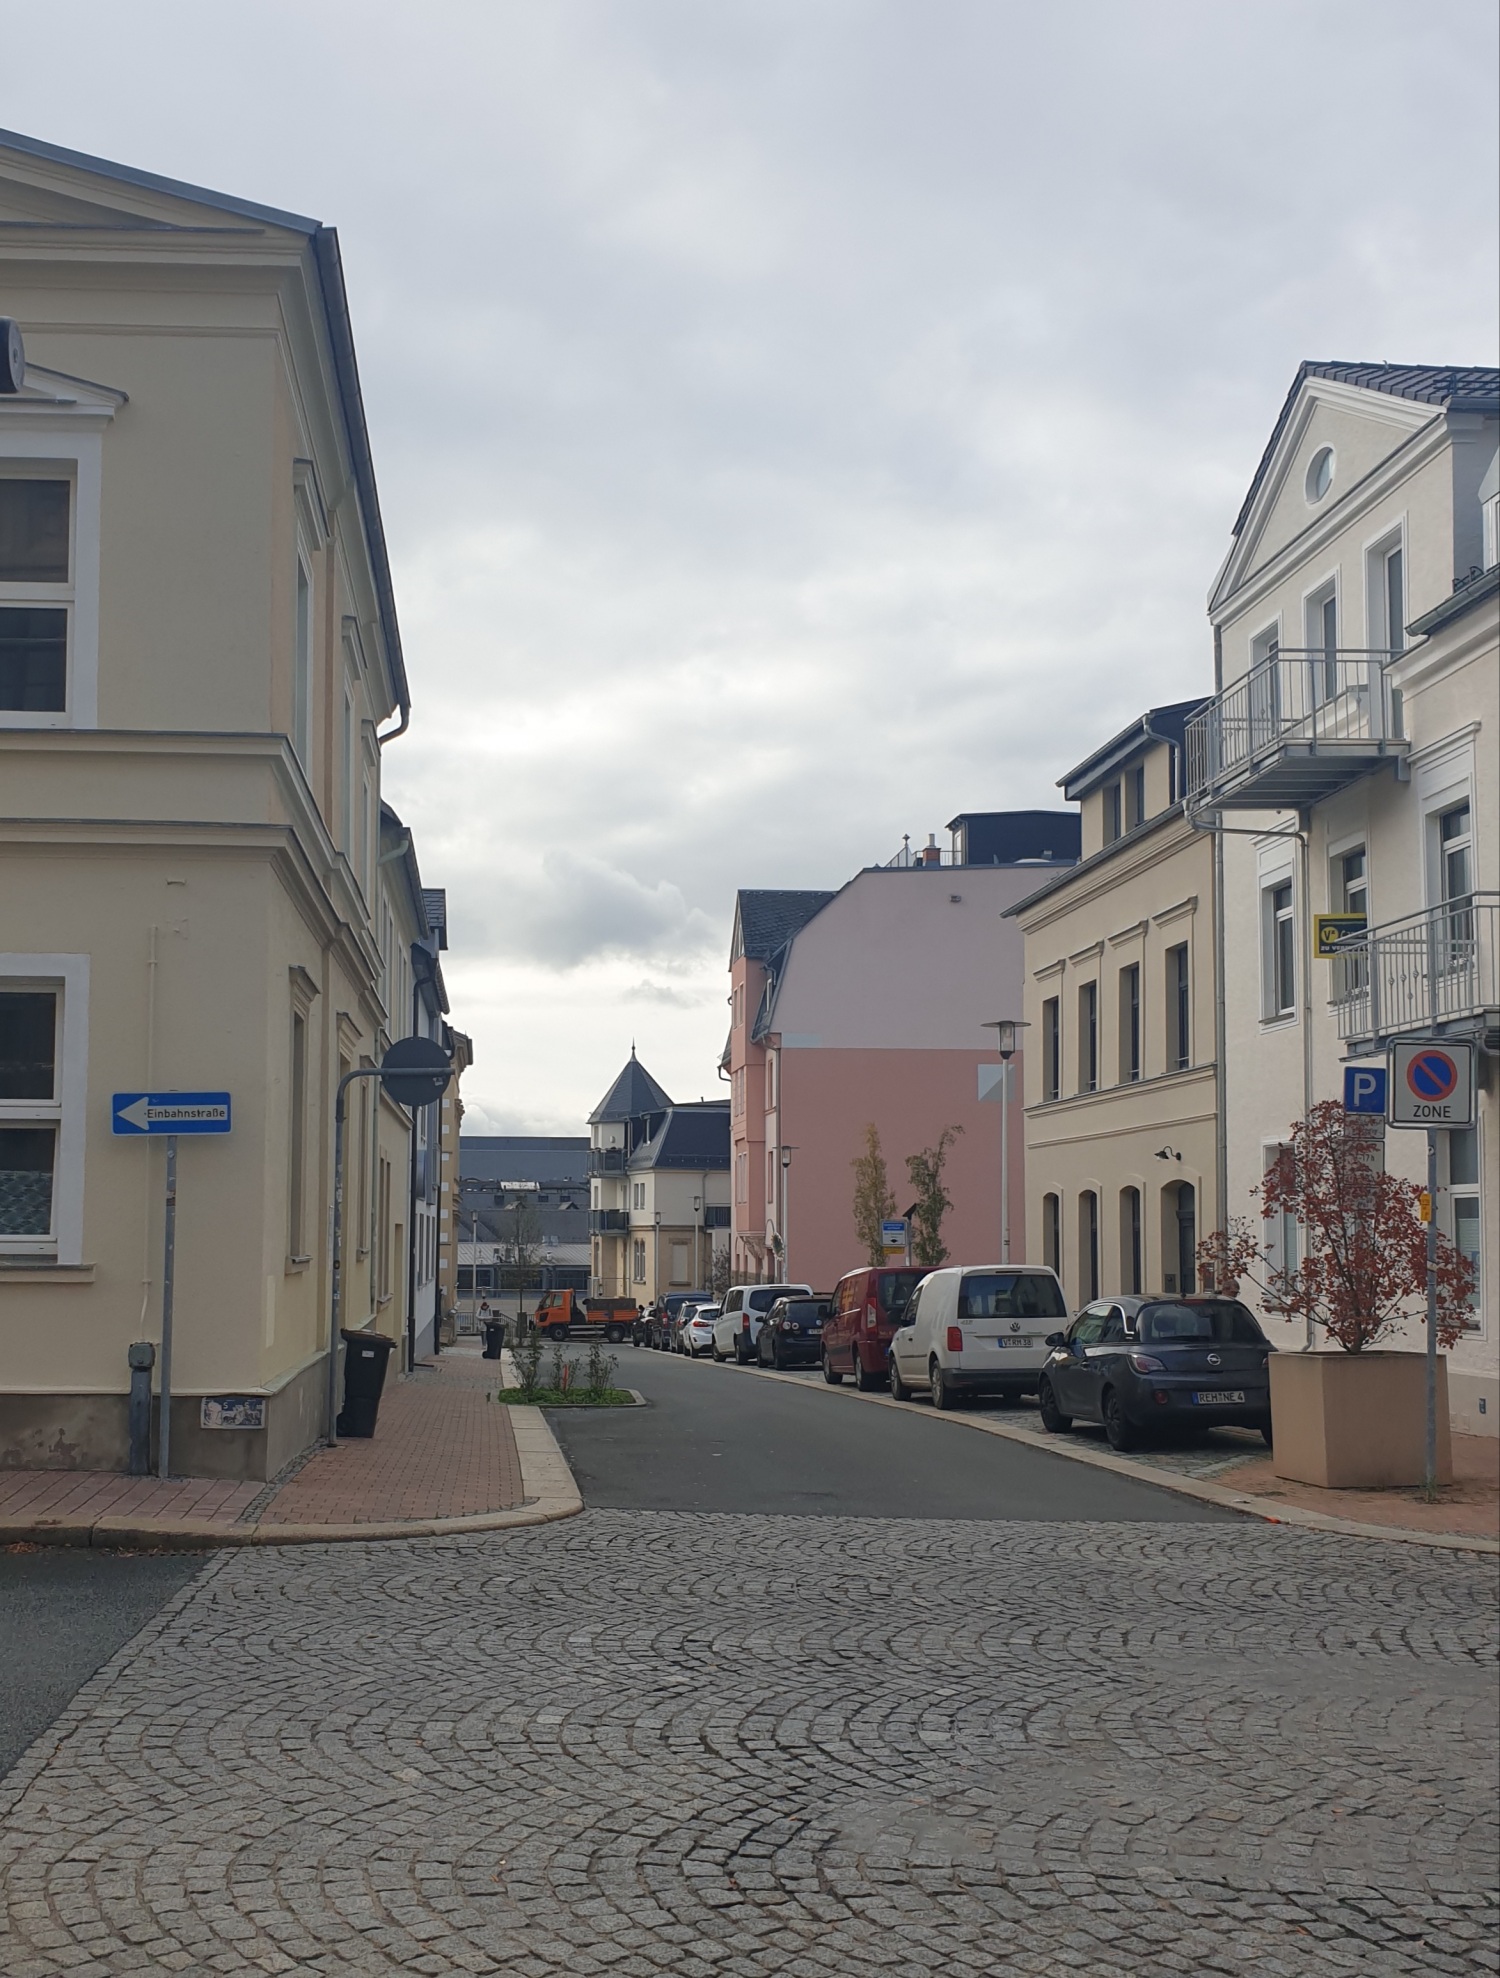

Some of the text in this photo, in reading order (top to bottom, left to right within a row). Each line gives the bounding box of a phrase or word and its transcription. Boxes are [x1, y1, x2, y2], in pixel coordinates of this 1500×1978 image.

[1353, 1072, 1377, 1107] P
[147, 1108, 226, 1119] Einbahnstraße
[1413, 1104, 1452, 1119] ZONE
[1199, 1392, 1244, 1402] REH NE 4
